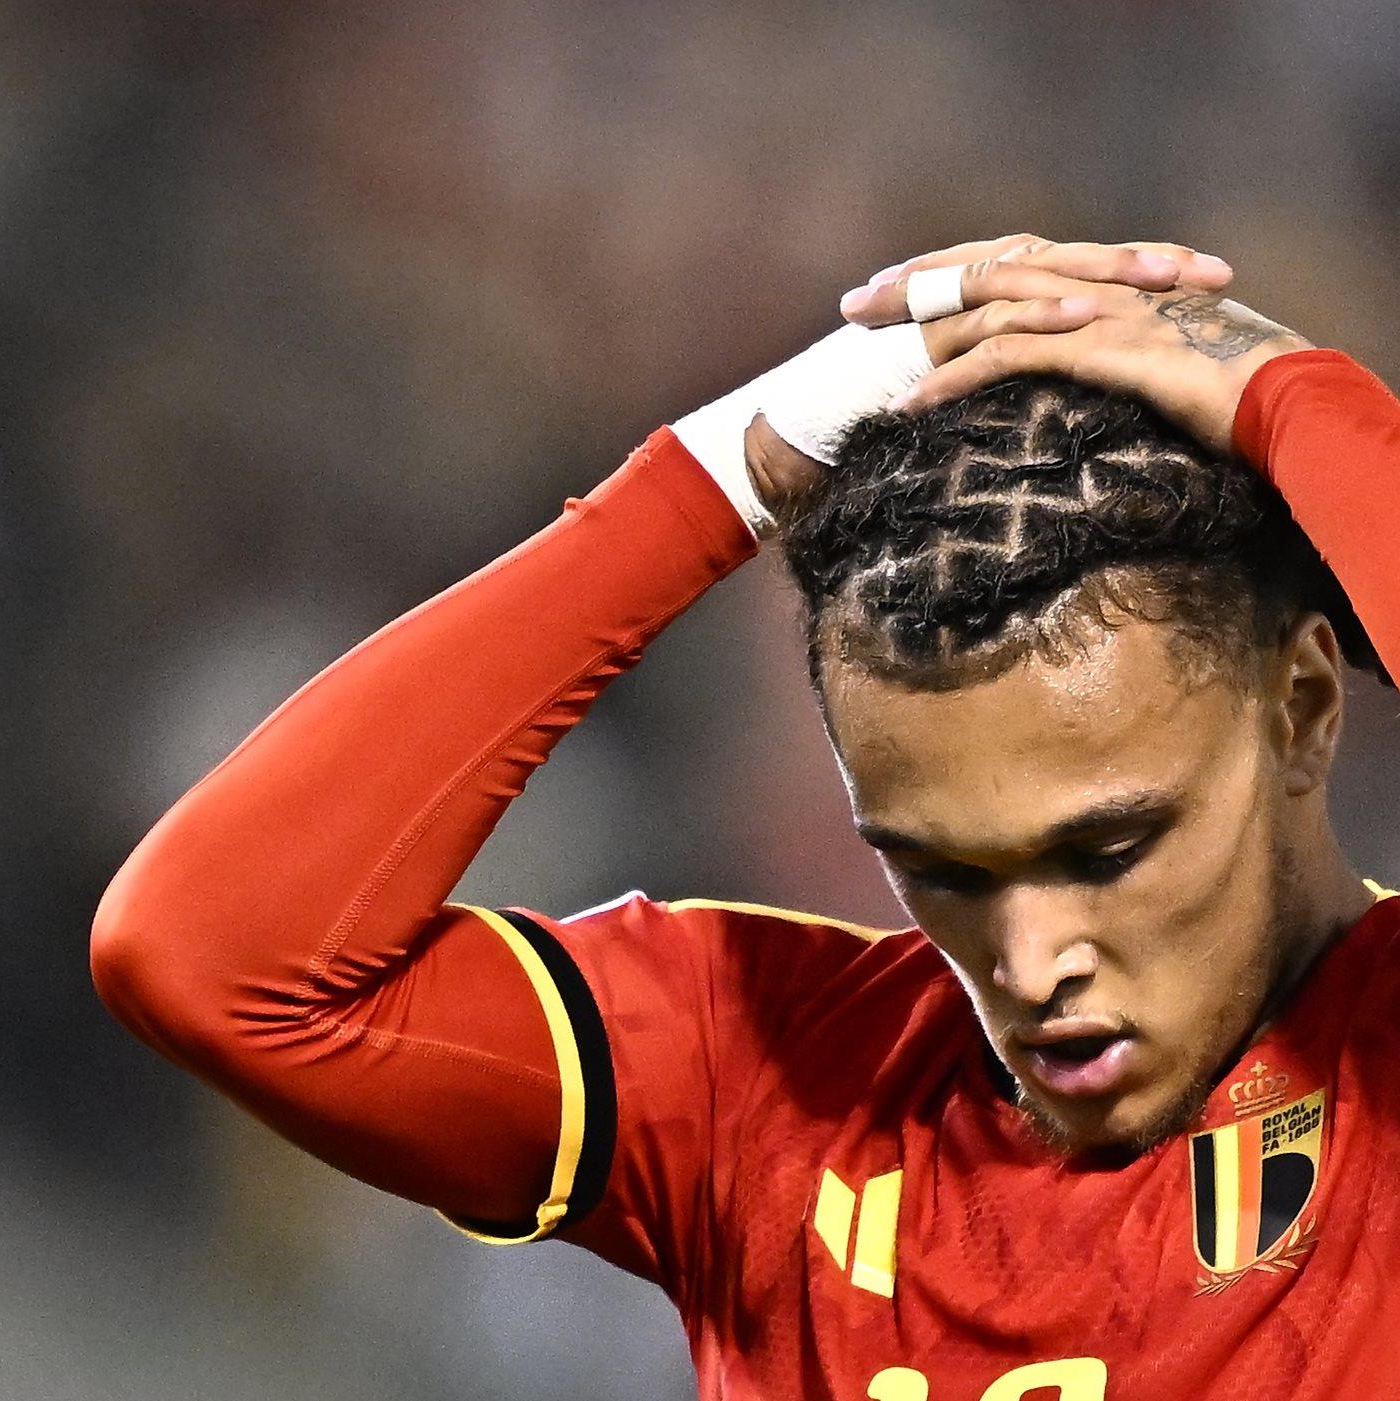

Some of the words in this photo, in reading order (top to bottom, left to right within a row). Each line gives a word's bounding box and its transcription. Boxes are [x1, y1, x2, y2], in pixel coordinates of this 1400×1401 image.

[1262, 1102, 1306, 1130] ROYAL
[1262, 1105, 1321, 1142] BELGIAN
[1262, 1140, 1280, 1155] FA
